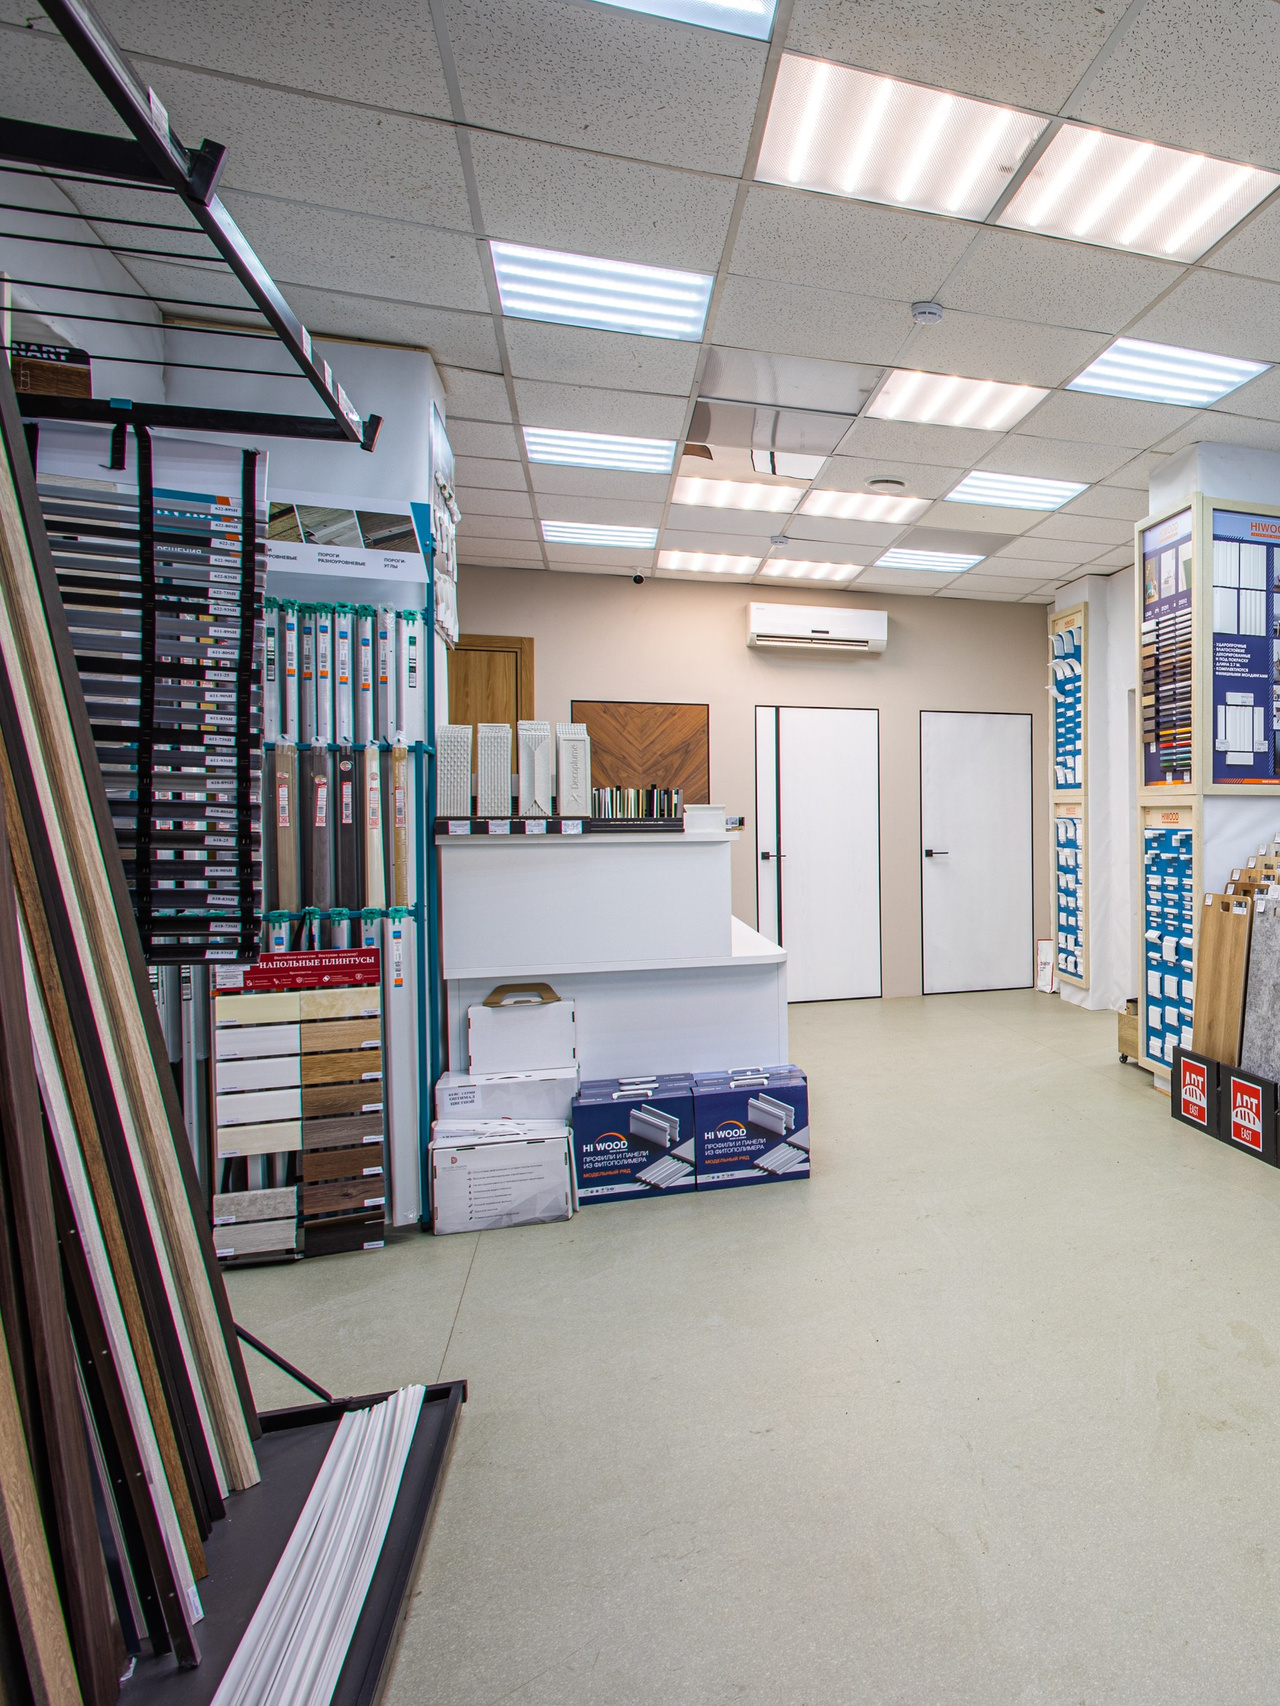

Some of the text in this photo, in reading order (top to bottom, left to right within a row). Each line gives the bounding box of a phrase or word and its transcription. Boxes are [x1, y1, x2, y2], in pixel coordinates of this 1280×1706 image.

[318, 558, 366, 566] РАЗНОУРОВНЕВЫЕ
[570, 744, 580, 790] Decoplume
[260, 956, 375, 969] НАПОЛЬНЫЕ ПЛИНТУСЫ
[1189, 1103, 1199, 1117] EAST
[704, 1128, 747, 1140] HI WOOD
[1240, 1127, 1252, 1142] EAST
[583, 1140, 628, 1153] HI WOOD
[704, 1141, 734, 1150] ПРОФИЛИ
[742, 1138, 766, 1146] ПАНЕЛИ
[714, 1144, 765, 1155] ФИТОПОЛИМЕРА
[583, 1153, 614, 1163] ПРОФИЛИ
[622, 1150, 649, 1158] ПАНЕЛИ
[593, 1157, 647, 1168] ФИТОПОЛИМЕРА
[705, 1156, 738, 1165] МОДЕЛЬНЫЙ
[583, 1170, 618, 1178] МОДЕЛЬНЫЙ
